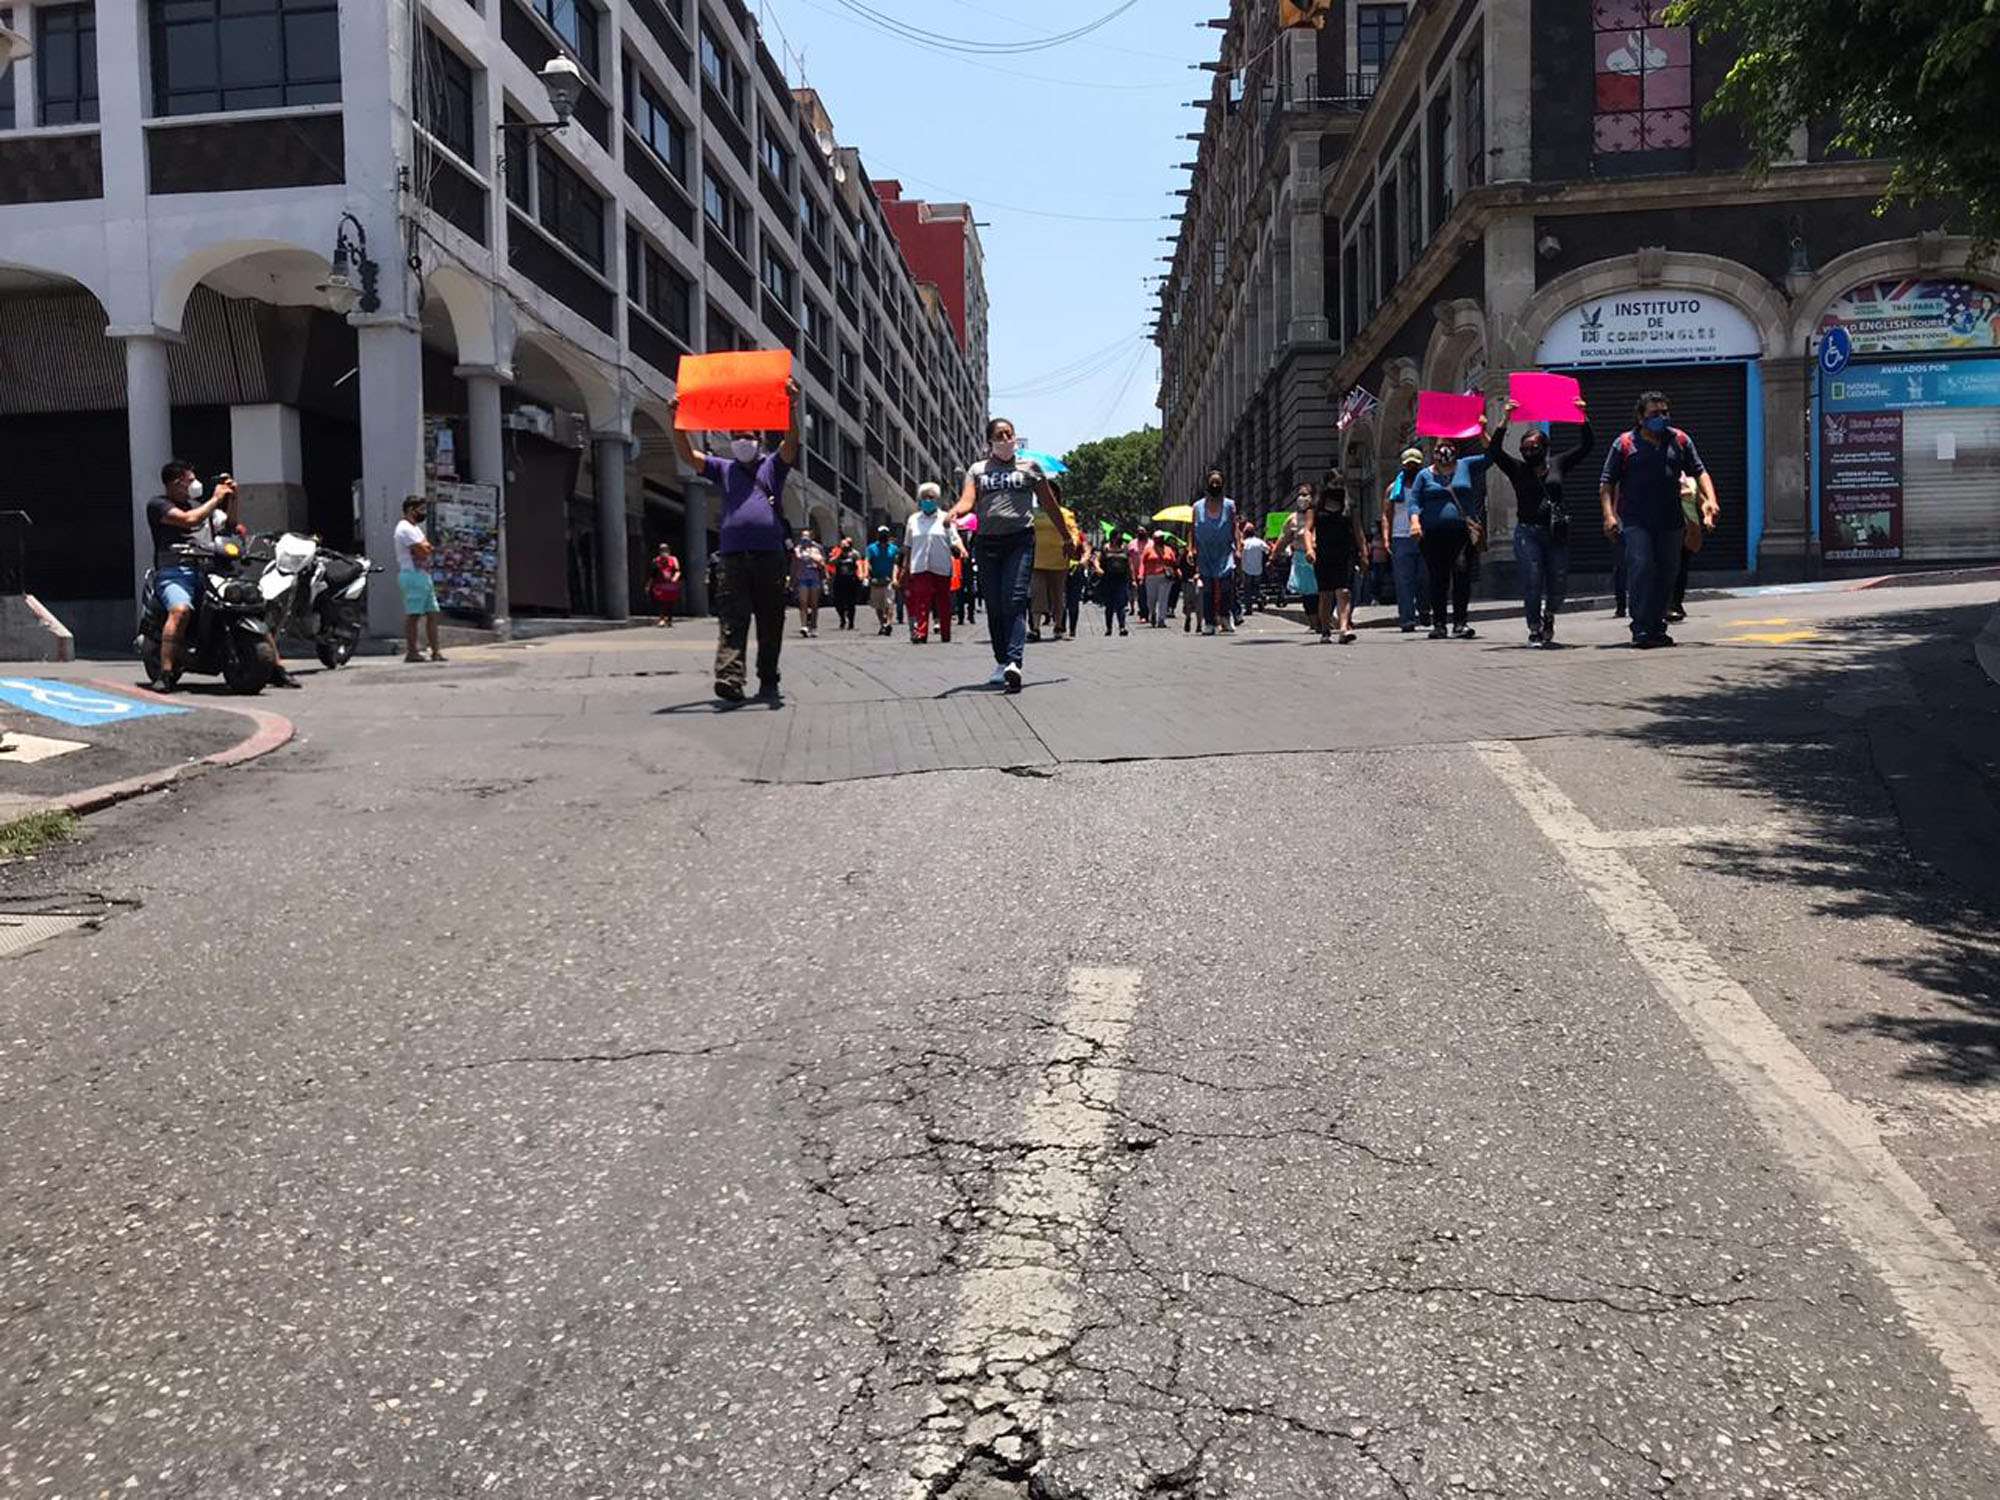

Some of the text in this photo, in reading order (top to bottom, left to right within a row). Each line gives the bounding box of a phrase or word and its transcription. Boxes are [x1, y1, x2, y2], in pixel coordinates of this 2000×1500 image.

[1615, 299, 1701, 316] INSTITUTO
[1647, 316, 1664, 328] DE
[1859, 317, 1909, 331] ENGLISH
[1911, 317, 1948, 328] COURSE
[1580, 348, 1613, 357] ESCUELA
[1880, 364, 1927, 374] AVALADOS
